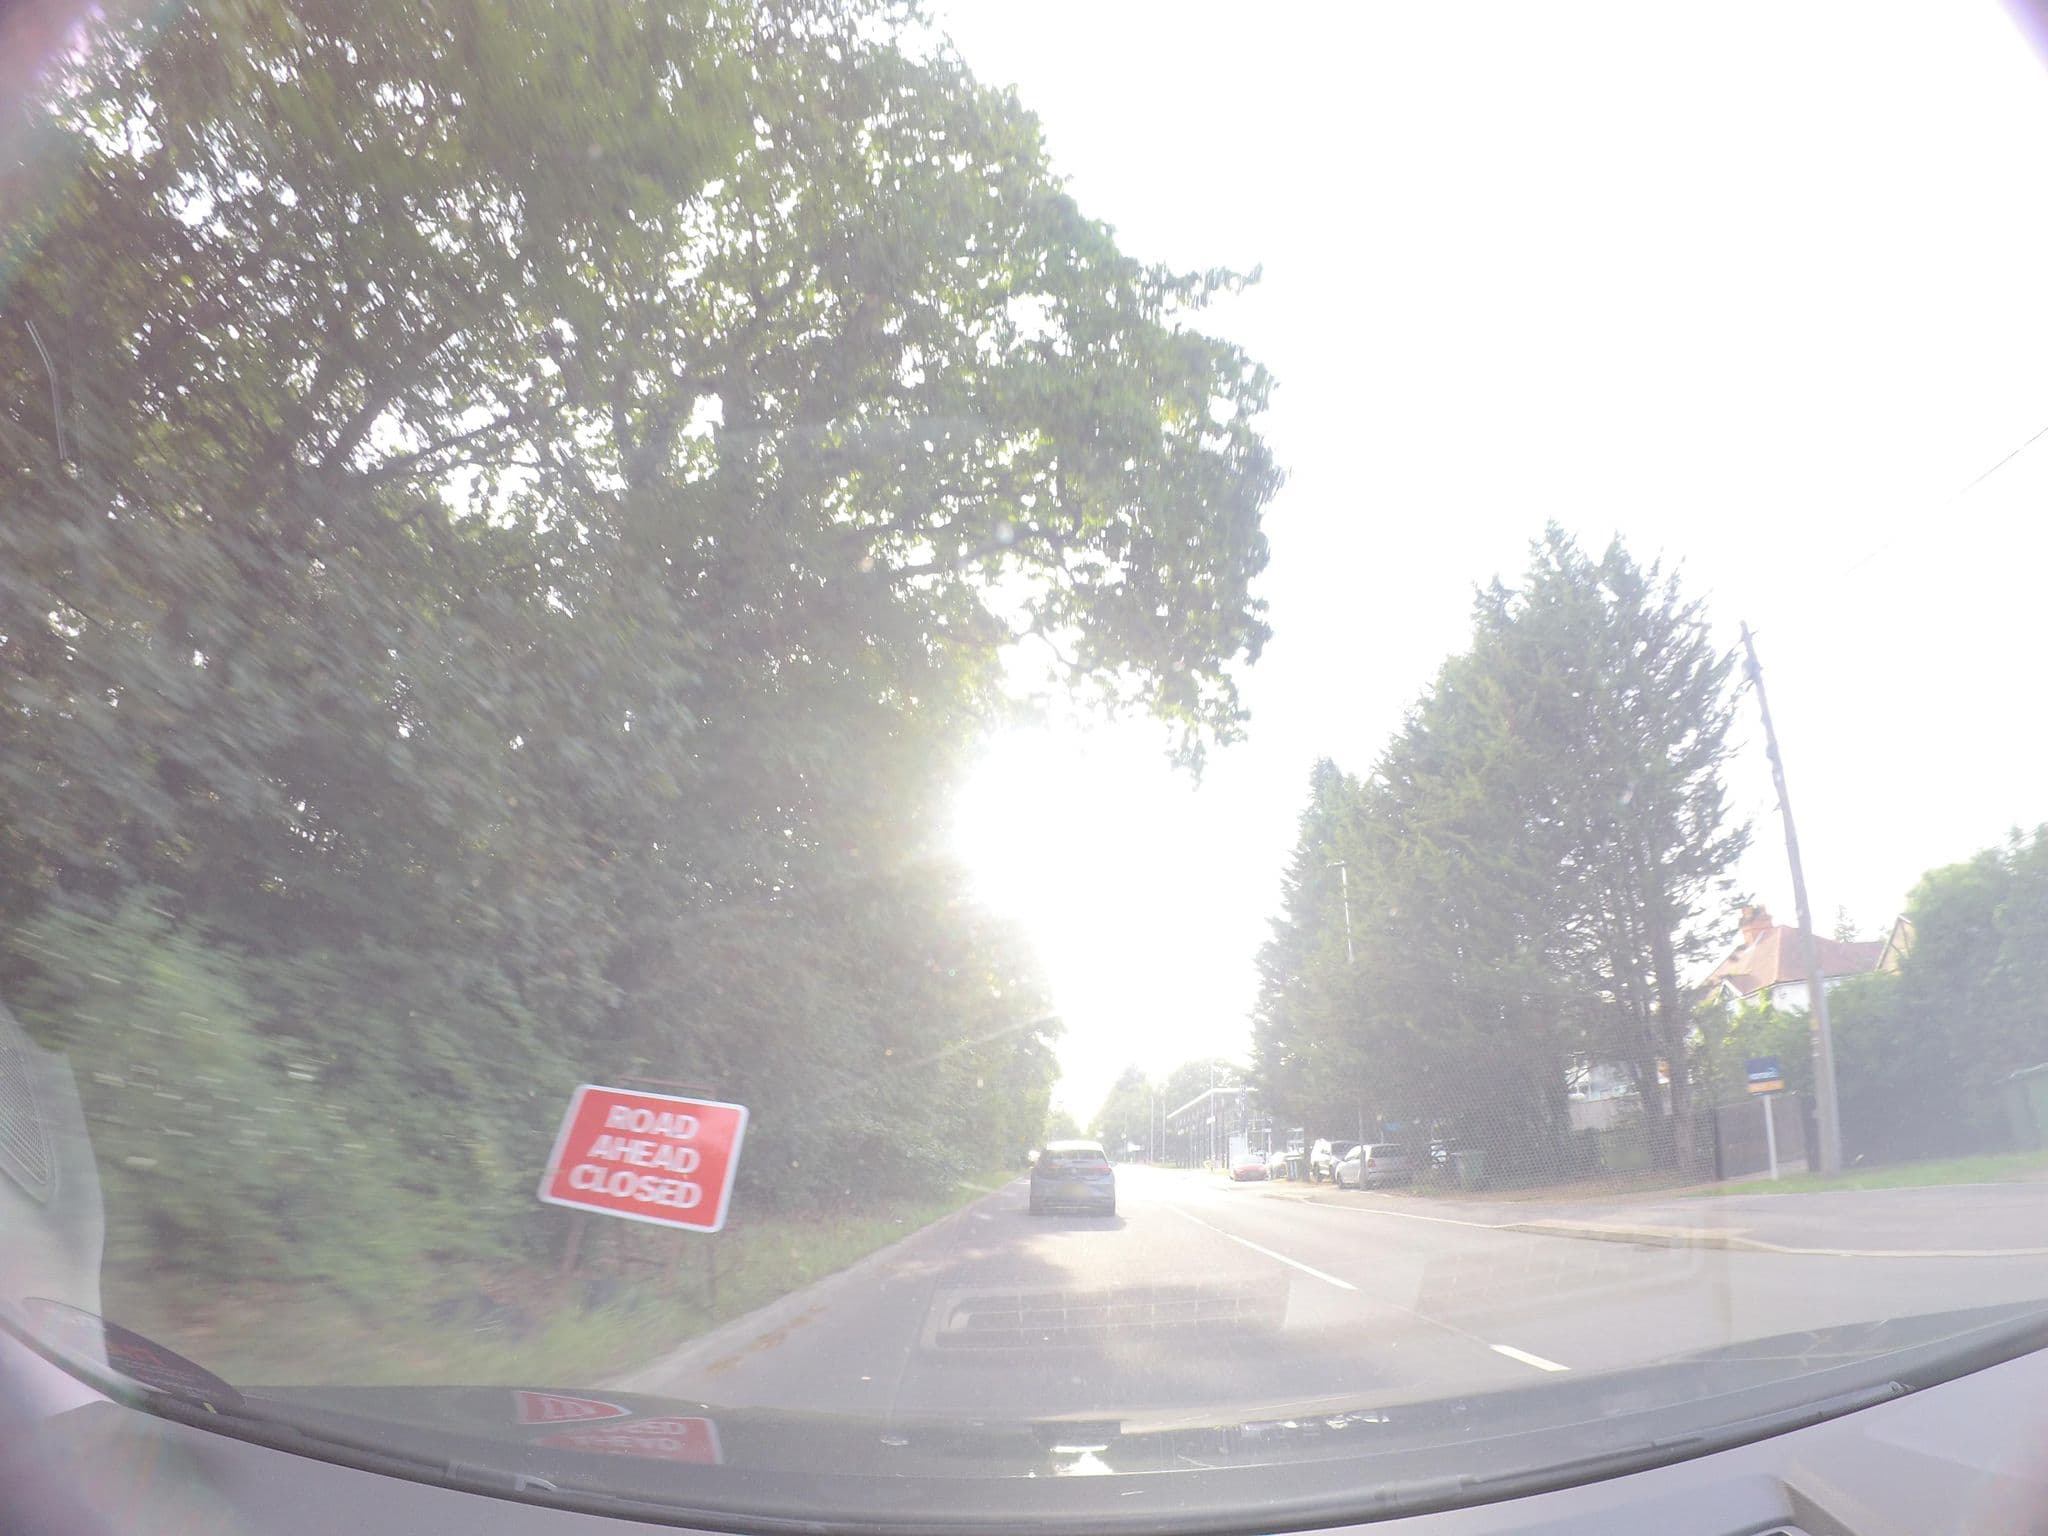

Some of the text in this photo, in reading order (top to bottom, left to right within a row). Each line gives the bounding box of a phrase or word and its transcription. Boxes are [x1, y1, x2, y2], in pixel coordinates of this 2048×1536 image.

[604, 1104, 699, 1140] ROAD
[586, 1134, 700, 1174] AHEAD
[568, 1163, 702, 1209] CLOSED
